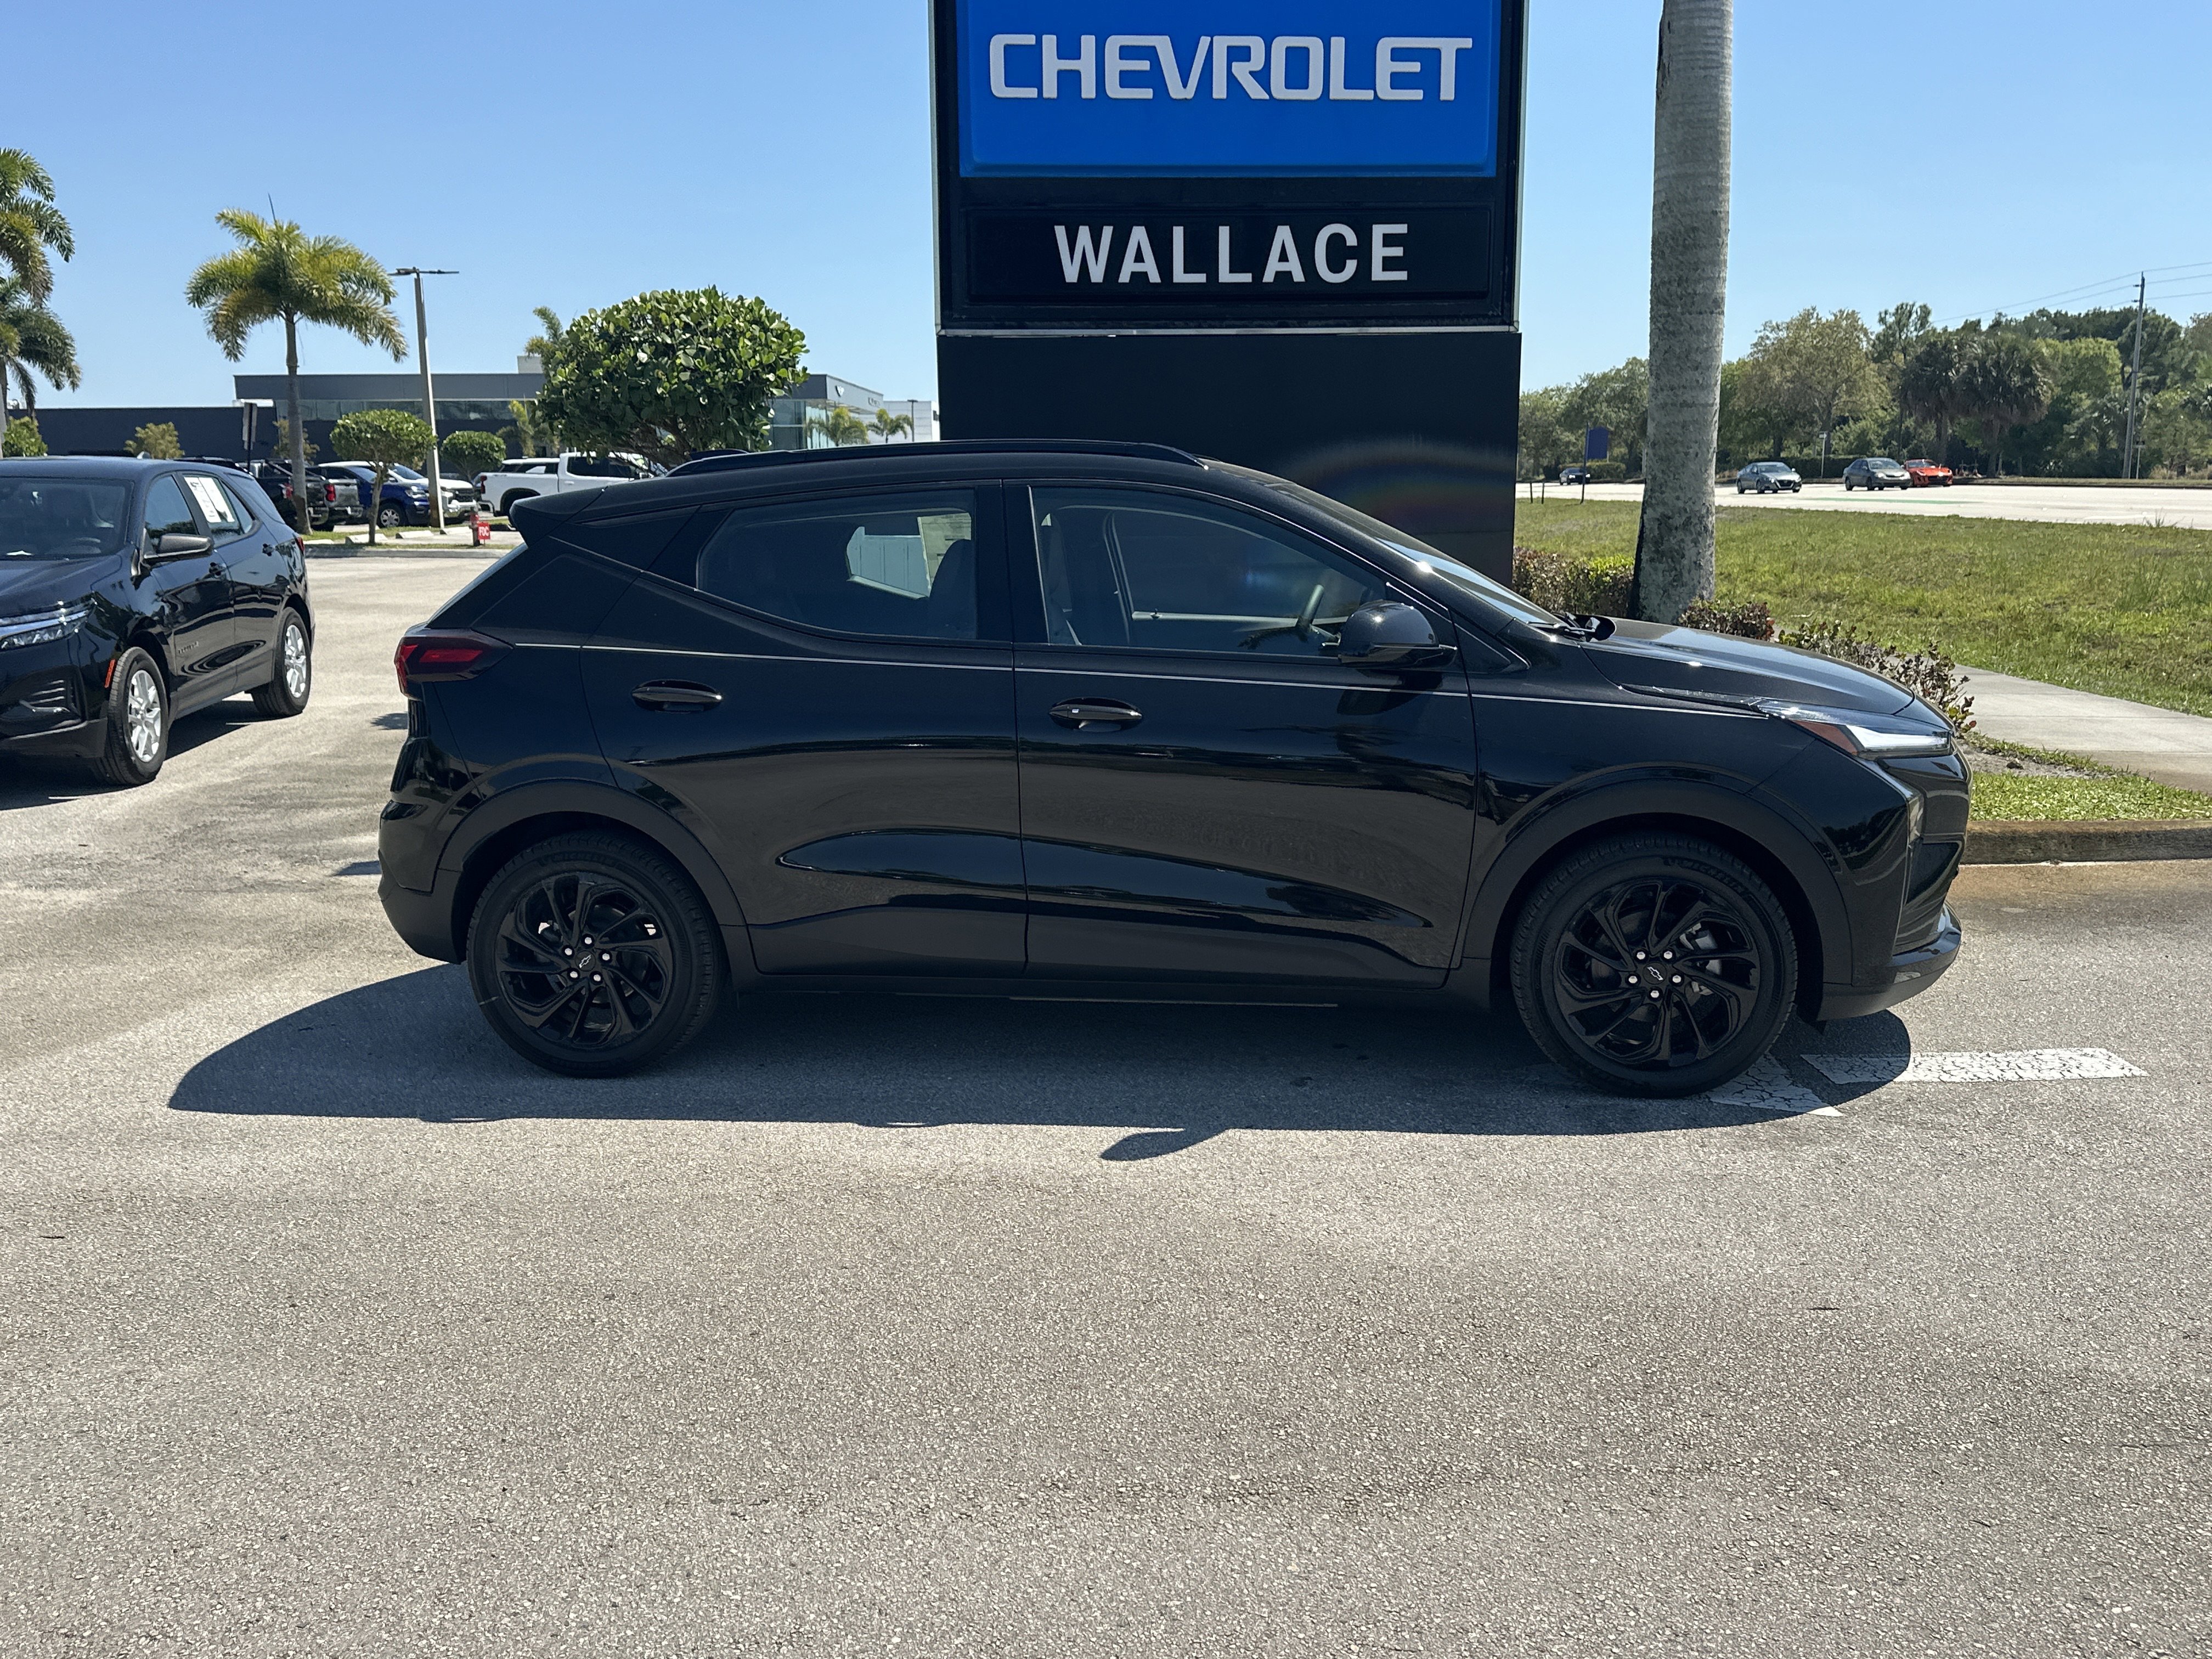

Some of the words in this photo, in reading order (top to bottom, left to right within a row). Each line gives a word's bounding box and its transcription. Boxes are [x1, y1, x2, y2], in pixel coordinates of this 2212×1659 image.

[990, 34, 1472, 100] CHEVROLET
[1054, 223, 1408, 283] WALLACE
[478, 526, 489, 537] FDC
